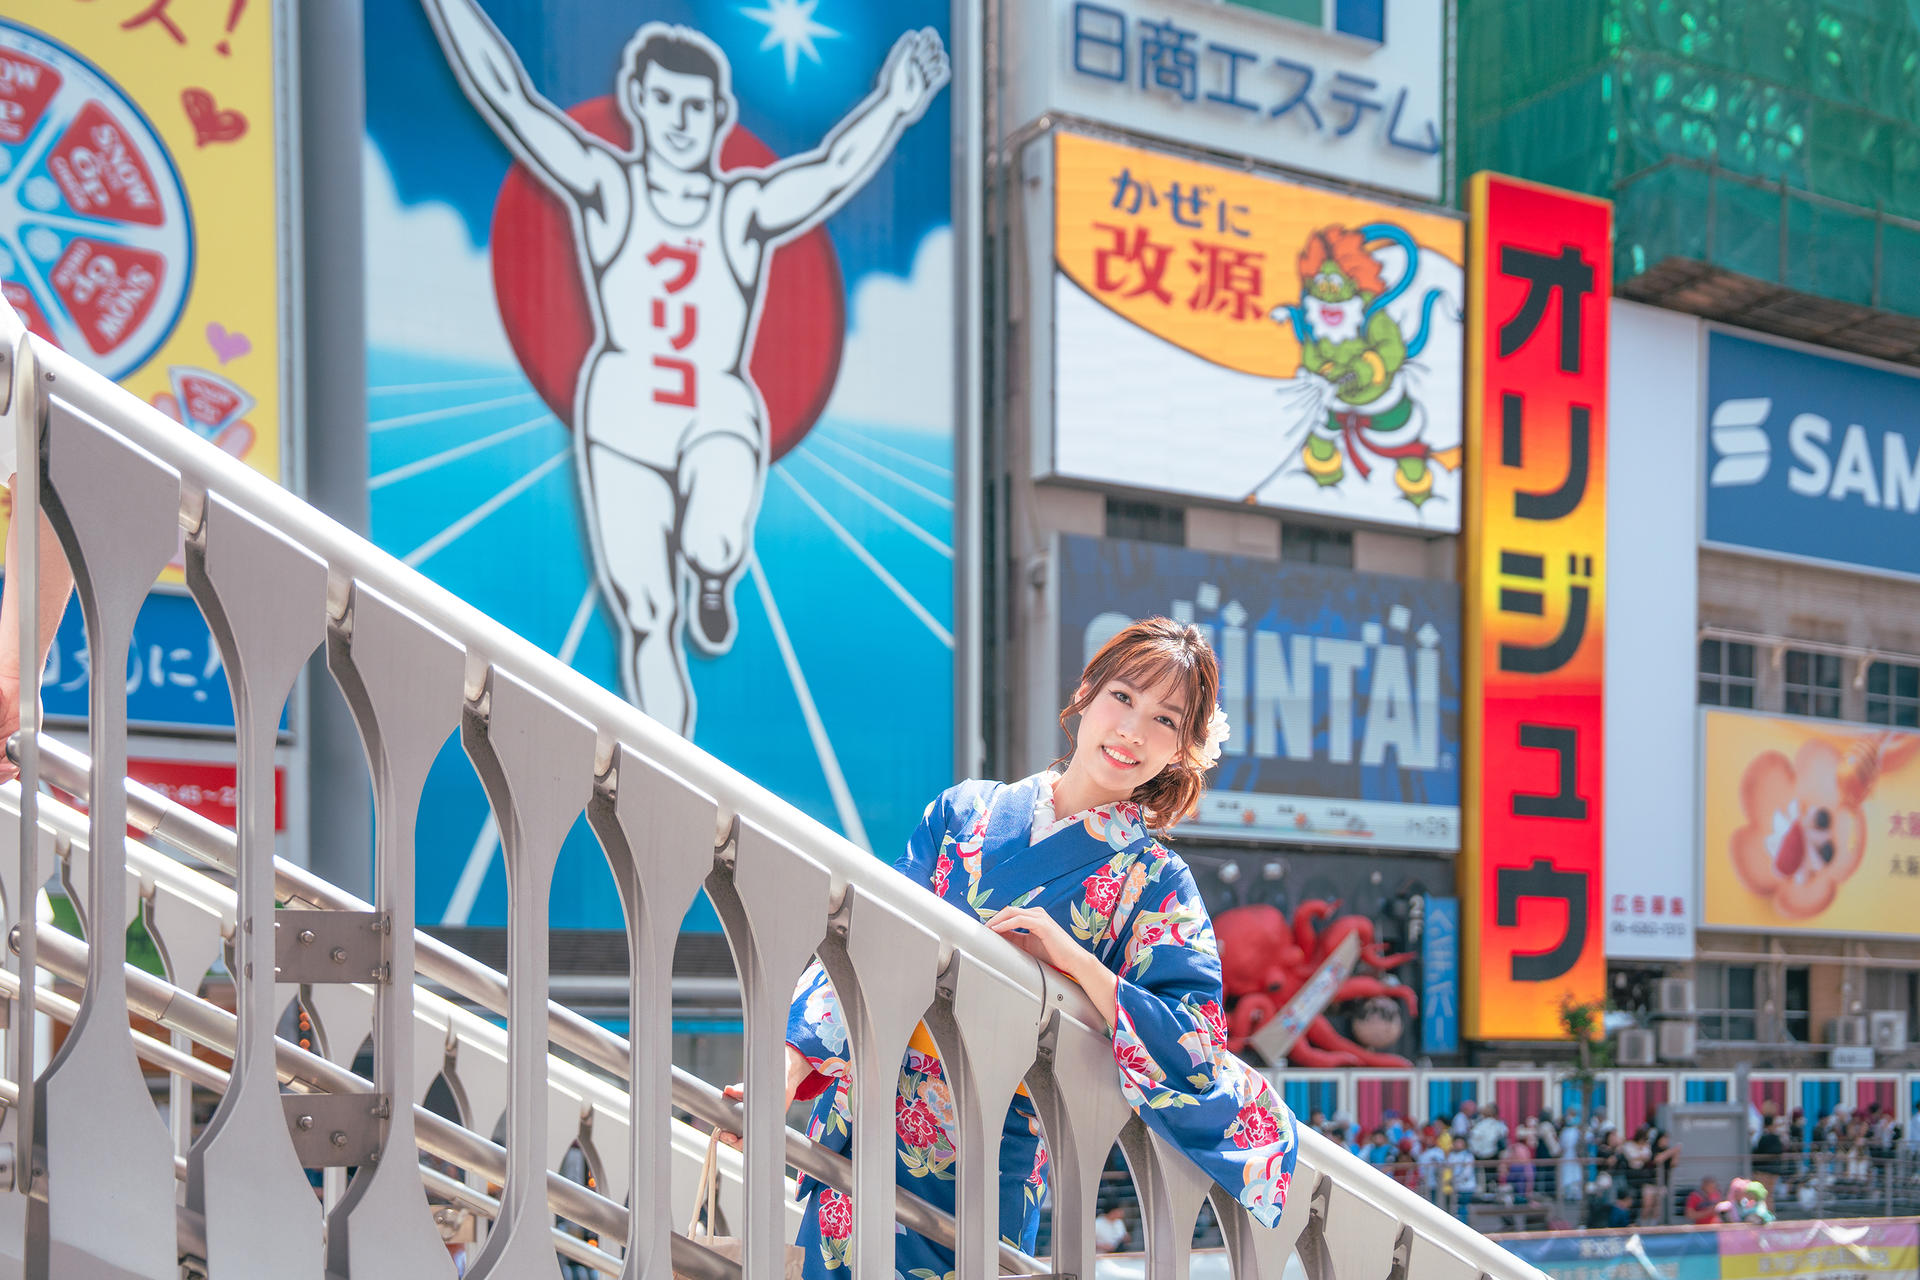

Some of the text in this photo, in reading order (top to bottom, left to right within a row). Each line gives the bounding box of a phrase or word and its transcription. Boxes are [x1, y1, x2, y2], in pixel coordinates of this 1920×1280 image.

[1074, 1, 1441, 157] 日商エステム
[1090, 220, 1269, 322] 改源
[1111, 168, 1252, 238] かぜに
[645, 237, 705, 409] グリコ
[1497, 244, 1597, 983] オリジュウ
